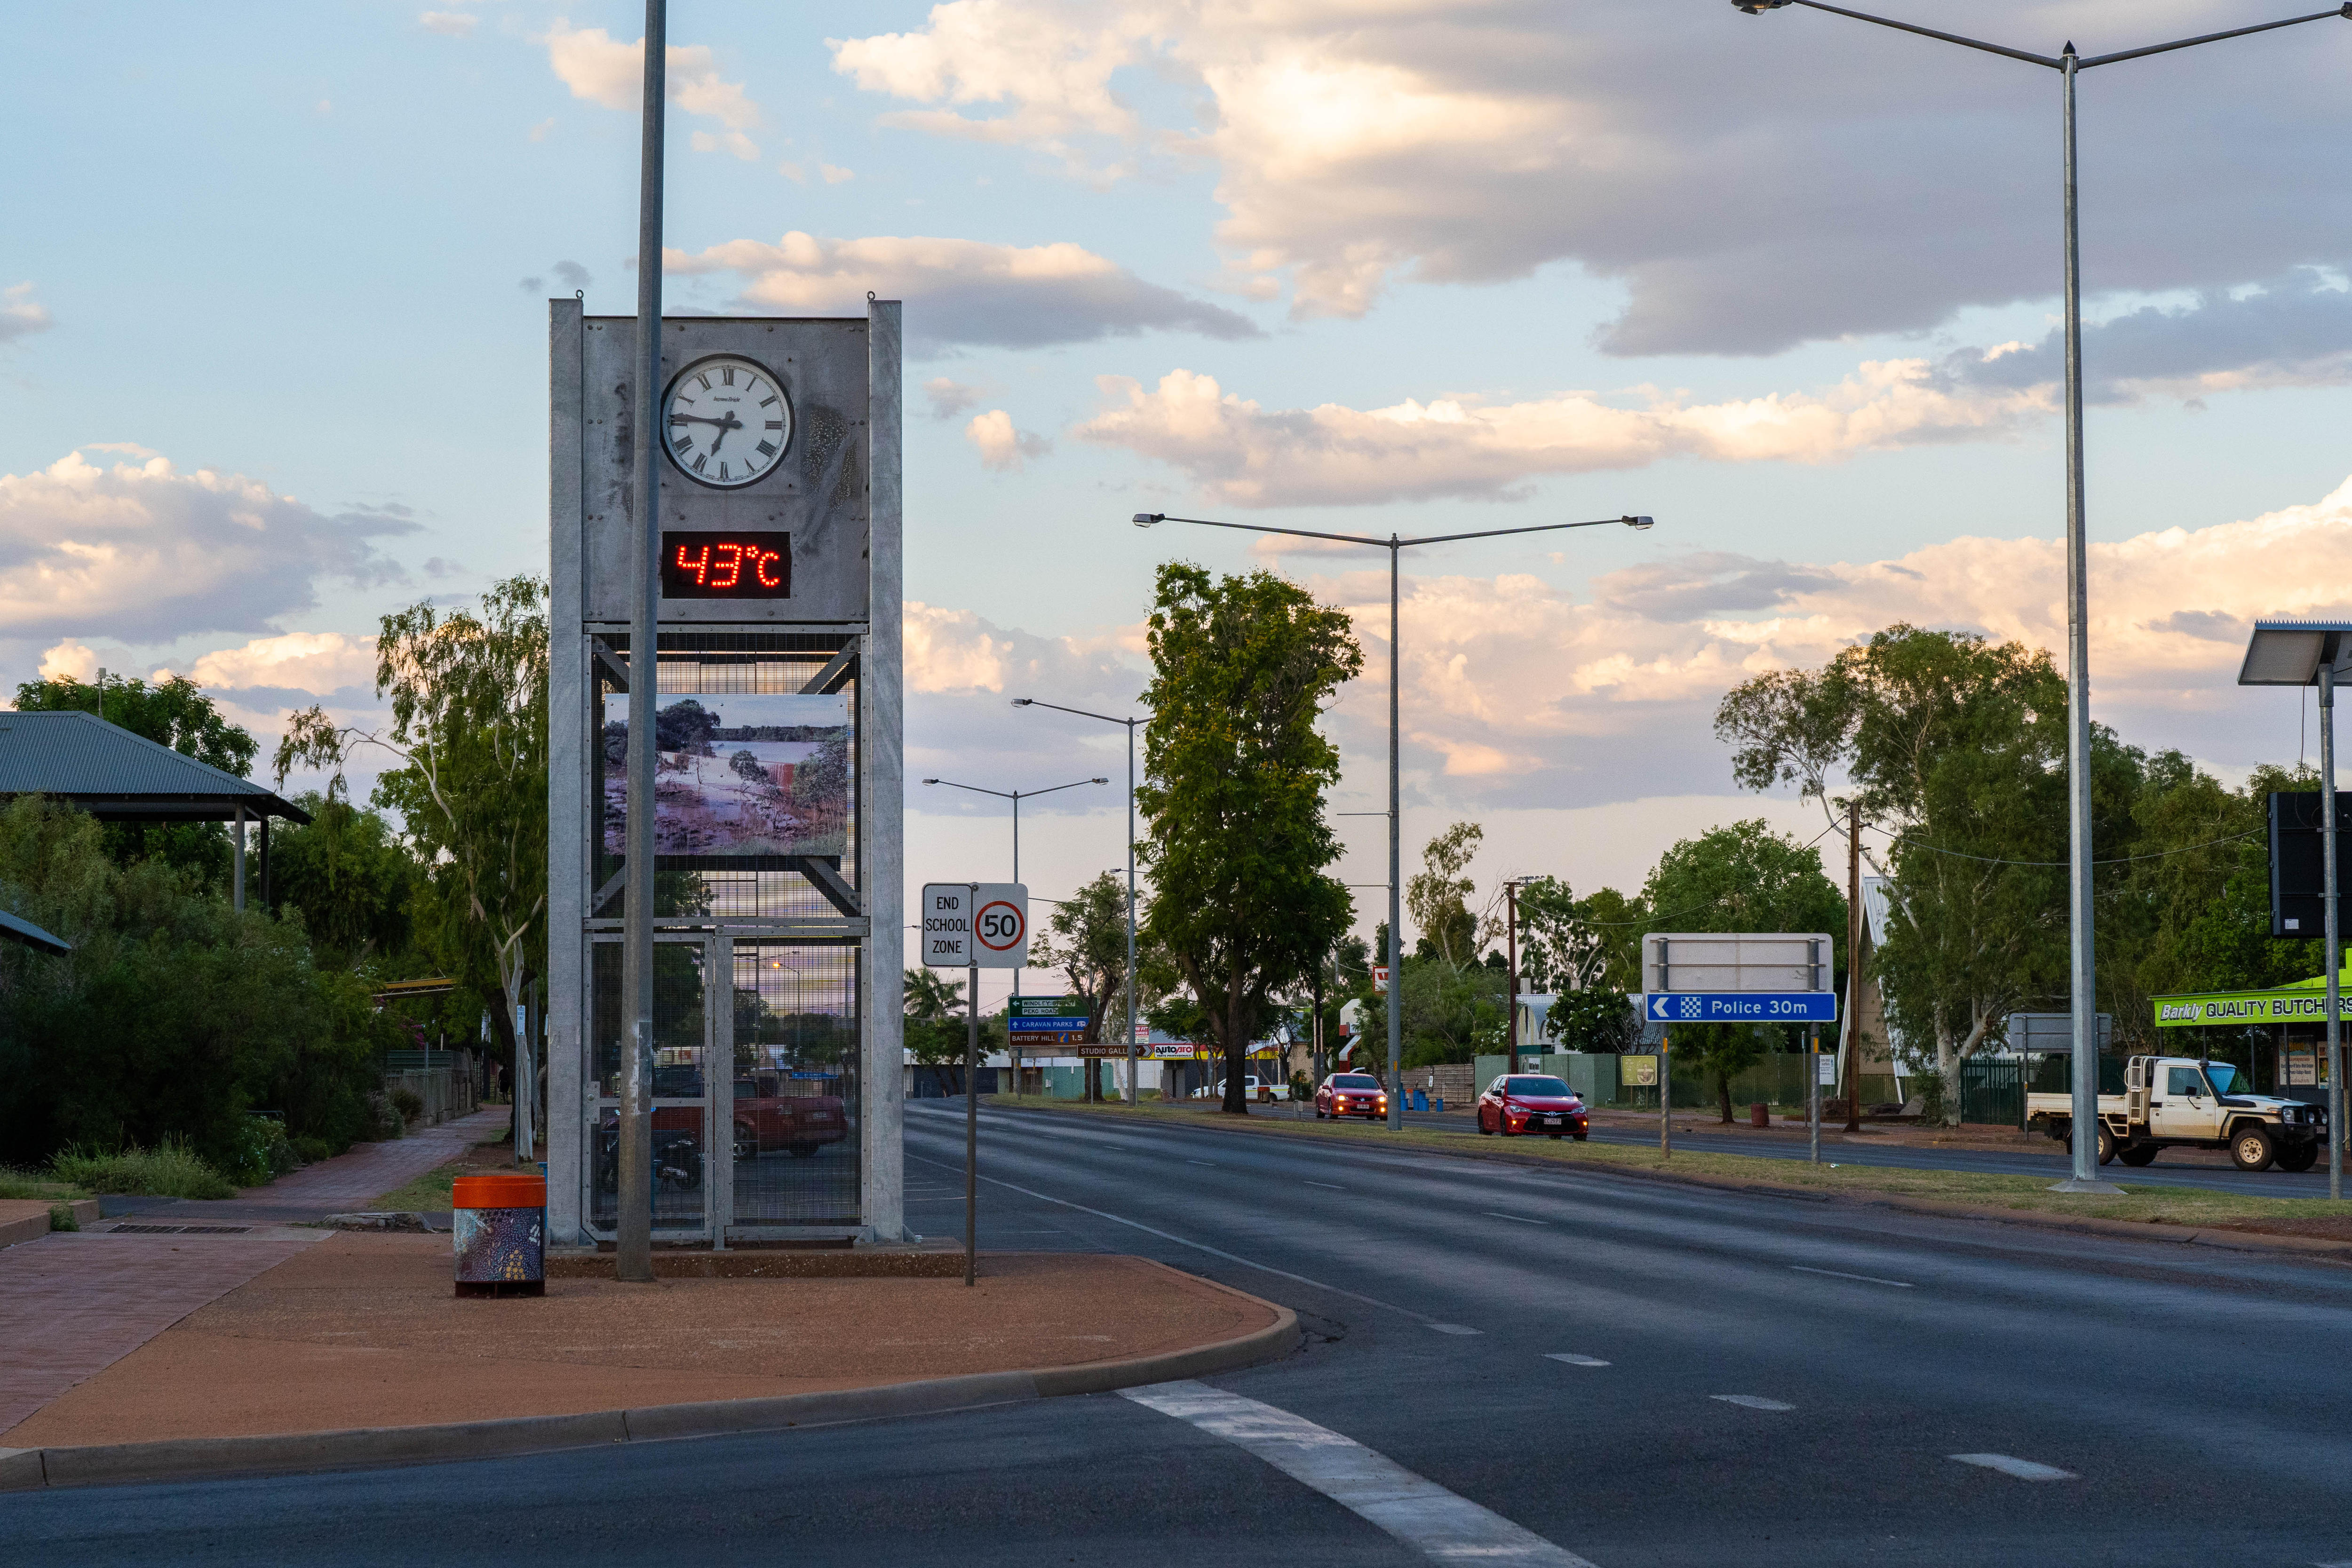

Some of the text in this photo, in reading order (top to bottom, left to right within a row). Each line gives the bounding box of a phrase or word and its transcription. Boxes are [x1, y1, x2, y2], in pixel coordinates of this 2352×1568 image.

[721, 369, 735, 386] XII
[744, 376, 757, 392] I
[758, 395, 777, 409] II
[764, 419, 782, 431] III
[937, 897, 959, 909] END
[925, 918, 970, 931] SCHOOL
[984, 915, 1016, 937] 50
[933, 940, 962, 953] ZONE
[1712, 1000, 1807, 1014] Police 30m
[2161, 996, 2352, 1021] Barkly QUALITY BUTCHRS
